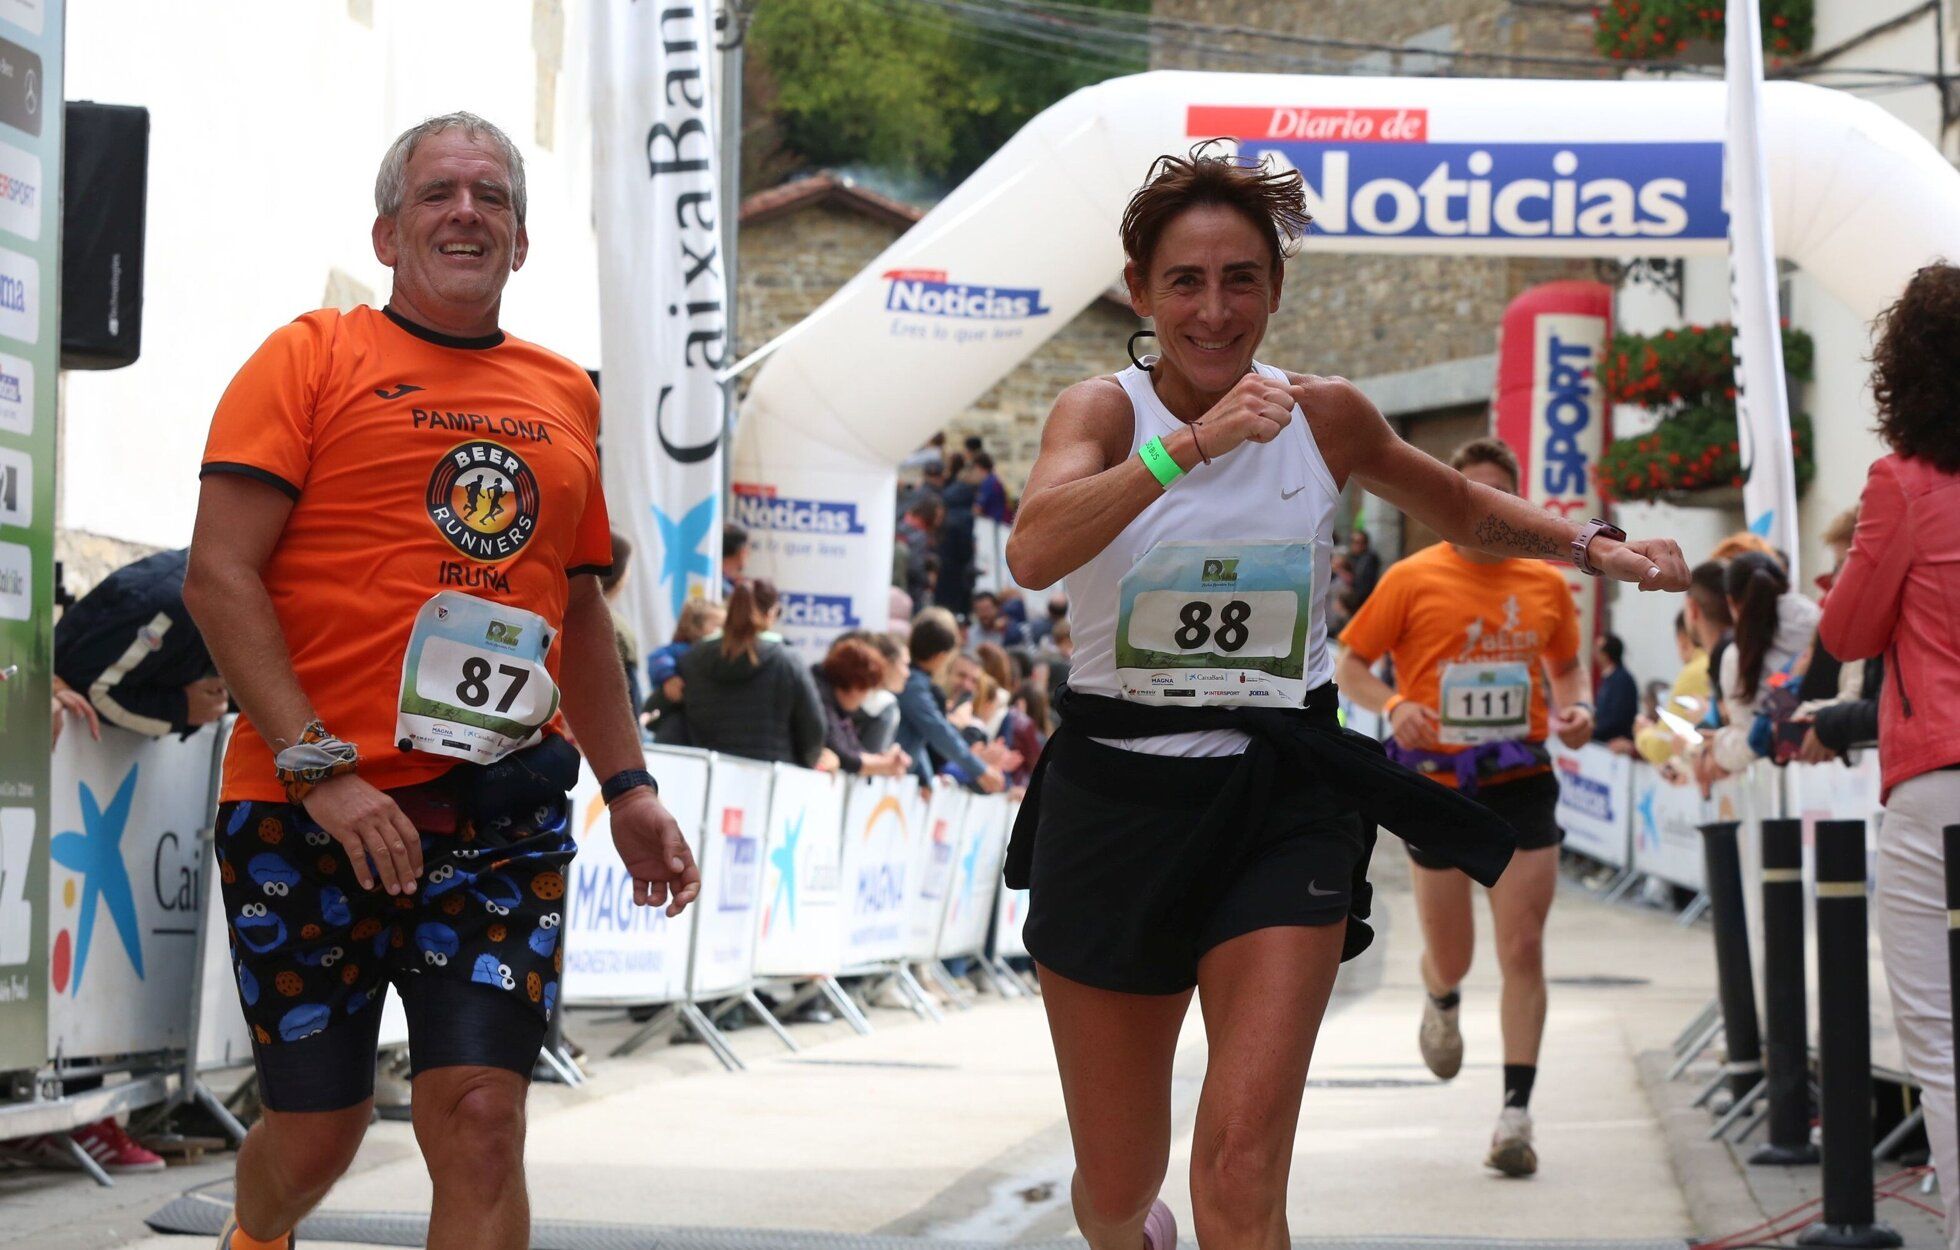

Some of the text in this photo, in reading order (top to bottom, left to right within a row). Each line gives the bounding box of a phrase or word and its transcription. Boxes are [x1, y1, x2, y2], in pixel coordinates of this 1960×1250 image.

[1265, 109, 1422, 140] Diario de
[1257, 150, 1689, 236] Noticias
[890, 280, 1030, 318] Noticias
[411, 408, 552, 444] PAMPLONA
[454, 446, 519, 475] BEER
[433, 506, 532, 555] RUNNERS
[737, 495, 850, 534] Noticias
[438, 560, 511, 593] IRUÑA
[1174, 600, 1251, 652] 88
[455, 656, 530, 714] 87
[1462, 691, 1510, 716] 111
